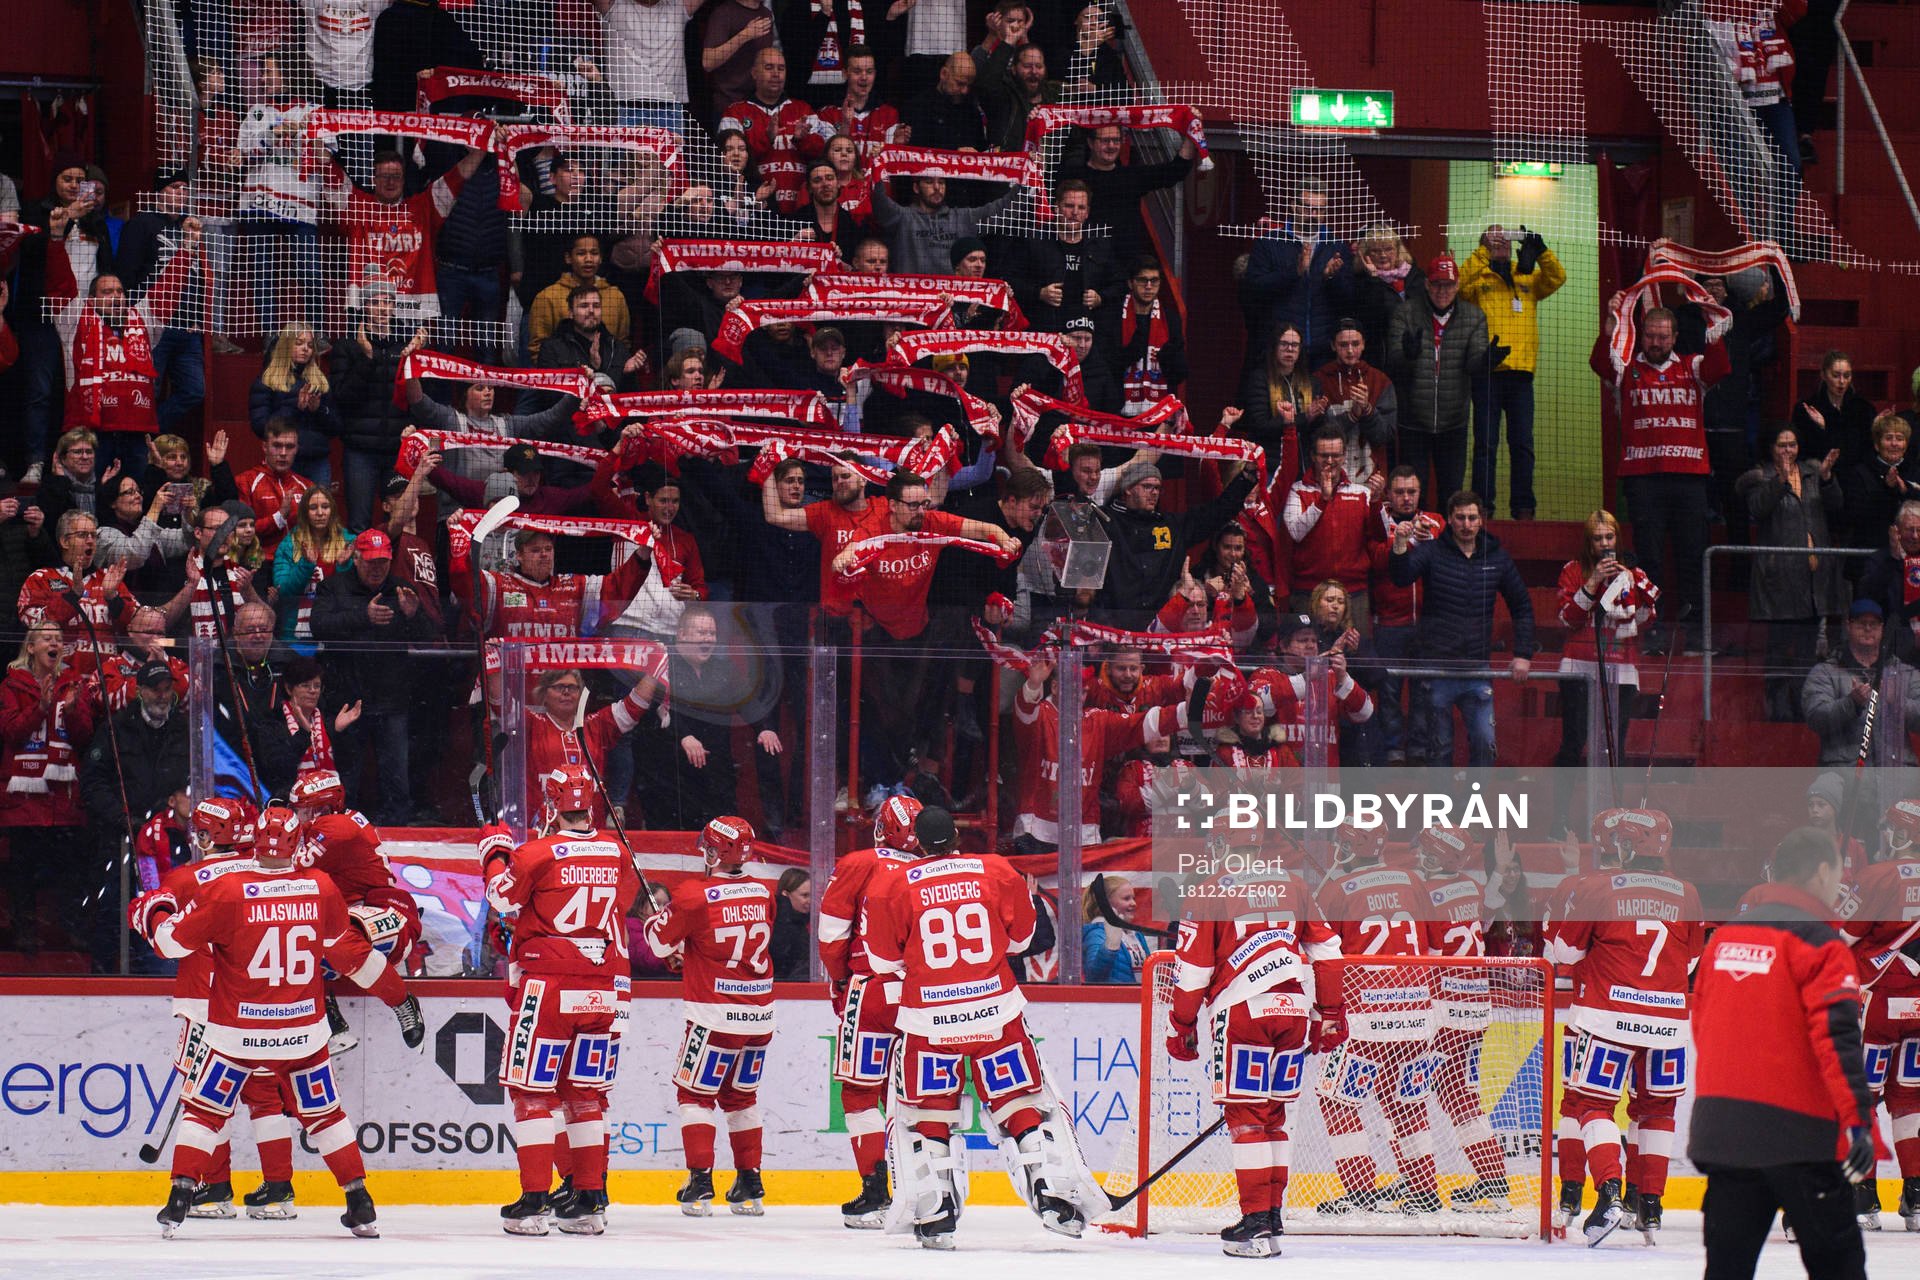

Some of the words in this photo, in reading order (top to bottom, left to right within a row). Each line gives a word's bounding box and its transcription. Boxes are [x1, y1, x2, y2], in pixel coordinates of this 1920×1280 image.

[1142, 108, 1174, 125] IK
[667, 241, 834, 261] TIMRÅSTORMEN
[815, 273, 1004, 295] TIMRÅSTORMEN
[415, 354, 590, 386] TIMRÅSTORMEN
[619, 390, 805, 408] TIMRÅSTORMEN
[525, 637, 616, 665] TIMRÅ
[623, 644, 656, 667] IK
[561, 864, 618, 885] SÖDERBERG
[920, 881, 981, 907] SVEDBERG
[1367, 892, 1402, 912] BOYCE
[248, 902, 319, 923] JALASVAARA
[553, 886, 617, 934] 47
[722, 904, 767, 923] OHLSSON
[1617, 899, 1679, 923] HARDEGÅRD
[919, 902, 994, 970] 89
[247, 925, 317, 987] 46
[714, 922, 771, 974] 72
[1636, 920, 1669, 977] 7
[1247, 956, 1294, 983] BILBOLAG
[923, 980, 1001, 999] Handelsbanken
[1612, 988, 1685, 1006] Handelsbanken
[240, 1003, 315, 1018] Handelsbanken
[572, 1004, 612, 1013] PROLYMPIA
[933, 1006, 1000, 1025] BILBOLAGET
[513, 994, 540, 1069] PEAB
[842, 988, 861, 1063] PEAB
[1616, 1020, 1678, 1038] BILBOLAGET
[242, 1034, 309, 1048] BILBOLAGET
[940, 1033, 995, 1044] PROLYMPIA
